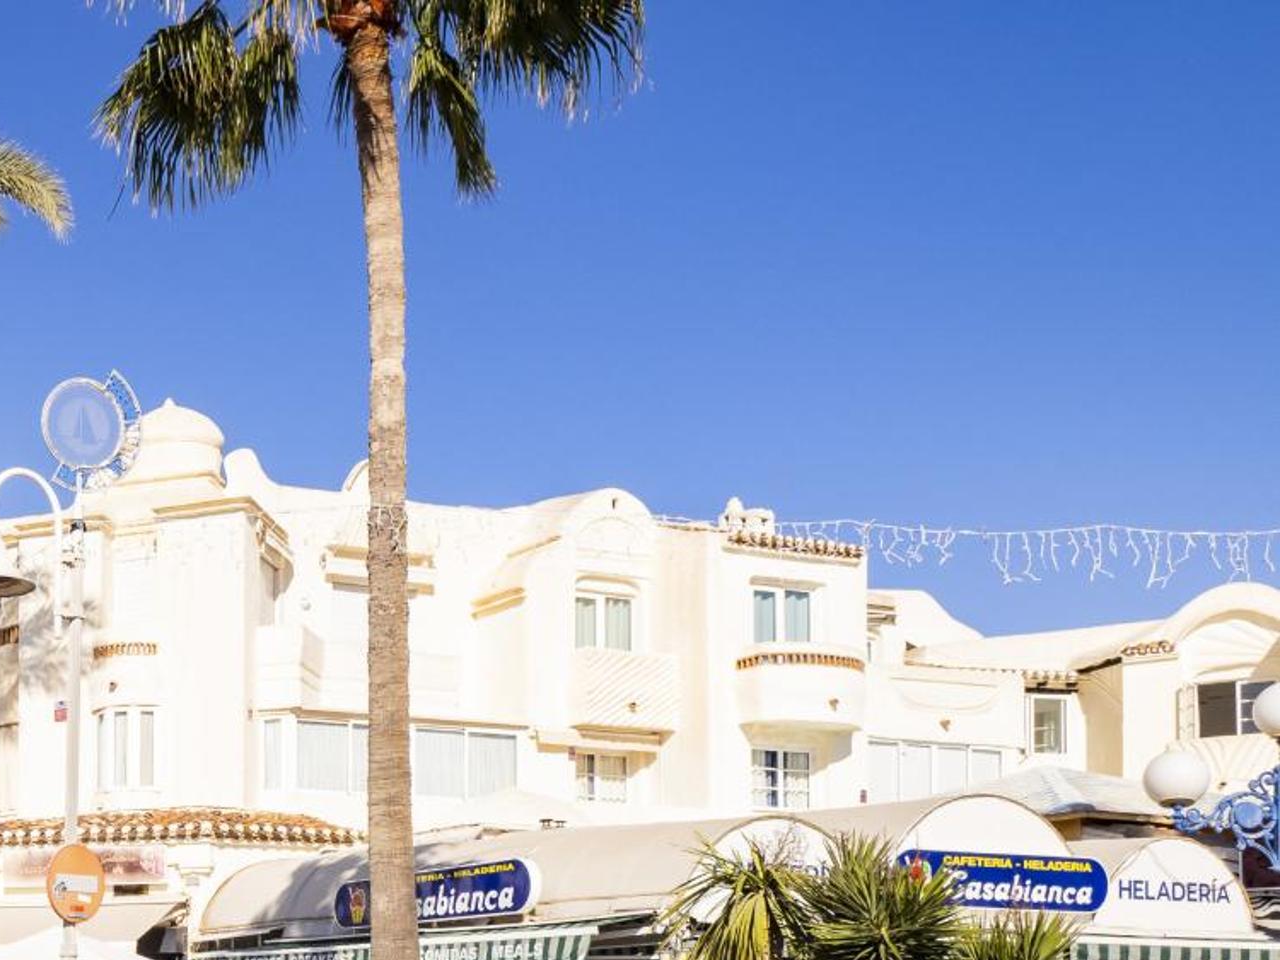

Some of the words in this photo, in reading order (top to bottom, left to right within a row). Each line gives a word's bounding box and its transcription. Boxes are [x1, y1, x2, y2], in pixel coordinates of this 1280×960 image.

[453, 863, 516, 878] HELADERIA
[943, 856, 1013, 869] CAFETERIA
[1023, 859, 1093, 872] HELADERIA
[943, 868, 1094, 905] Casabianca
[1118, 878, 1231, 904] HELADERÍA
